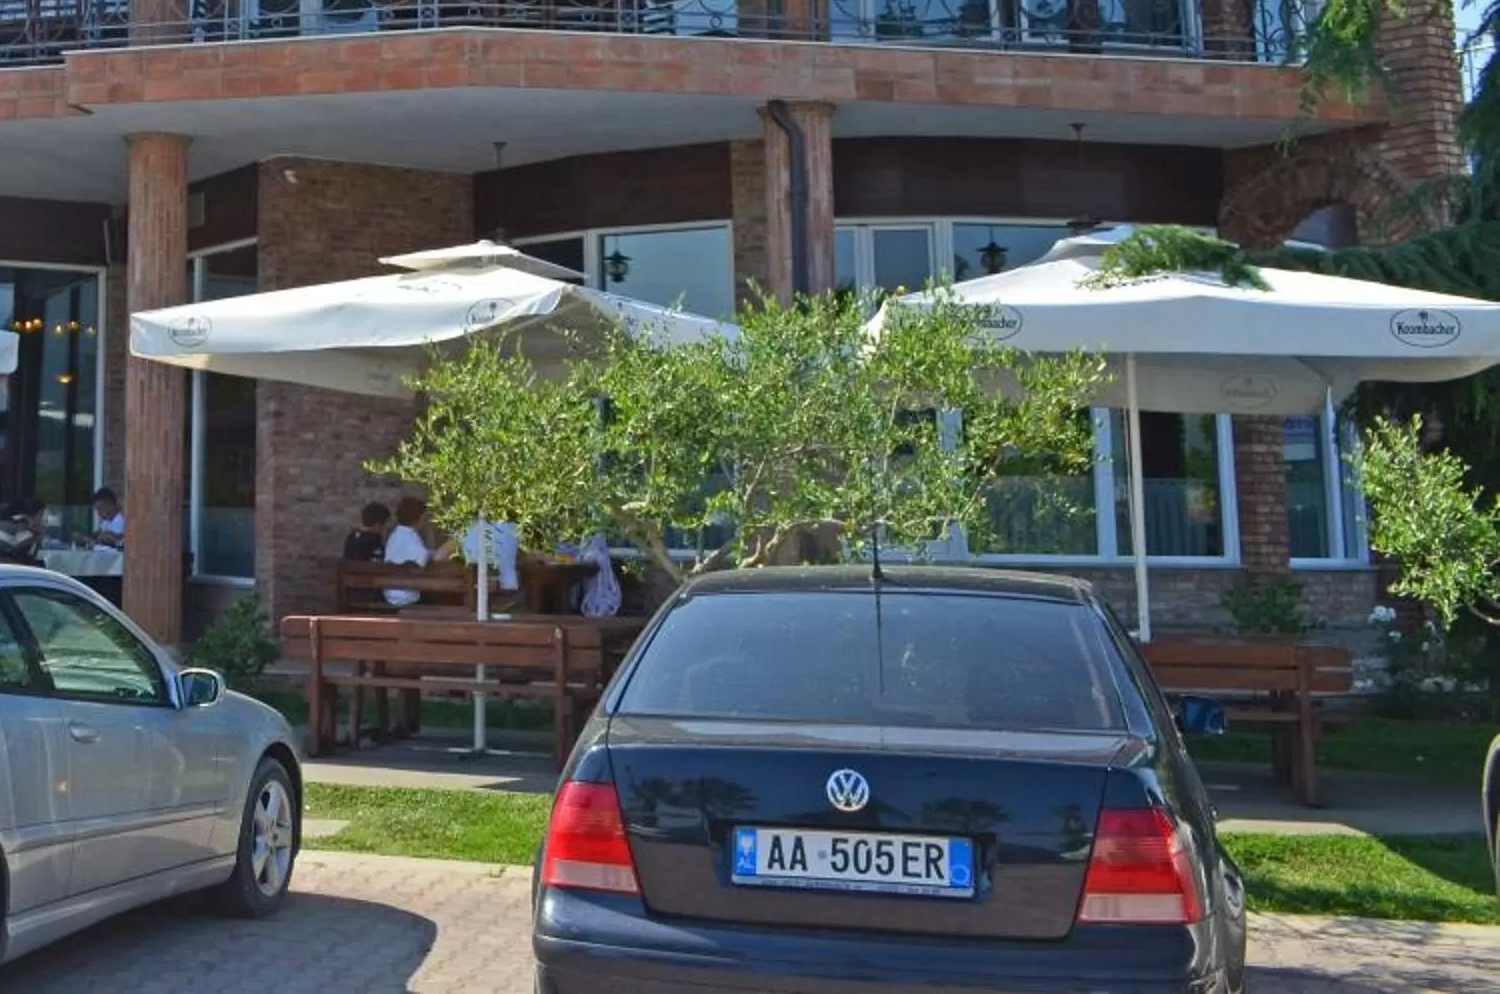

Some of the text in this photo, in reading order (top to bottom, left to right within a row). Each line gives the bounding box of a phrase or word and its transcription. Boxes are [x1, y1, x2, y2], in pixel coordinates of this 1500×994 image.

[1396, 321, 1456, 335] Krombacher
[766, 834, 946, 880] AA 505ER
